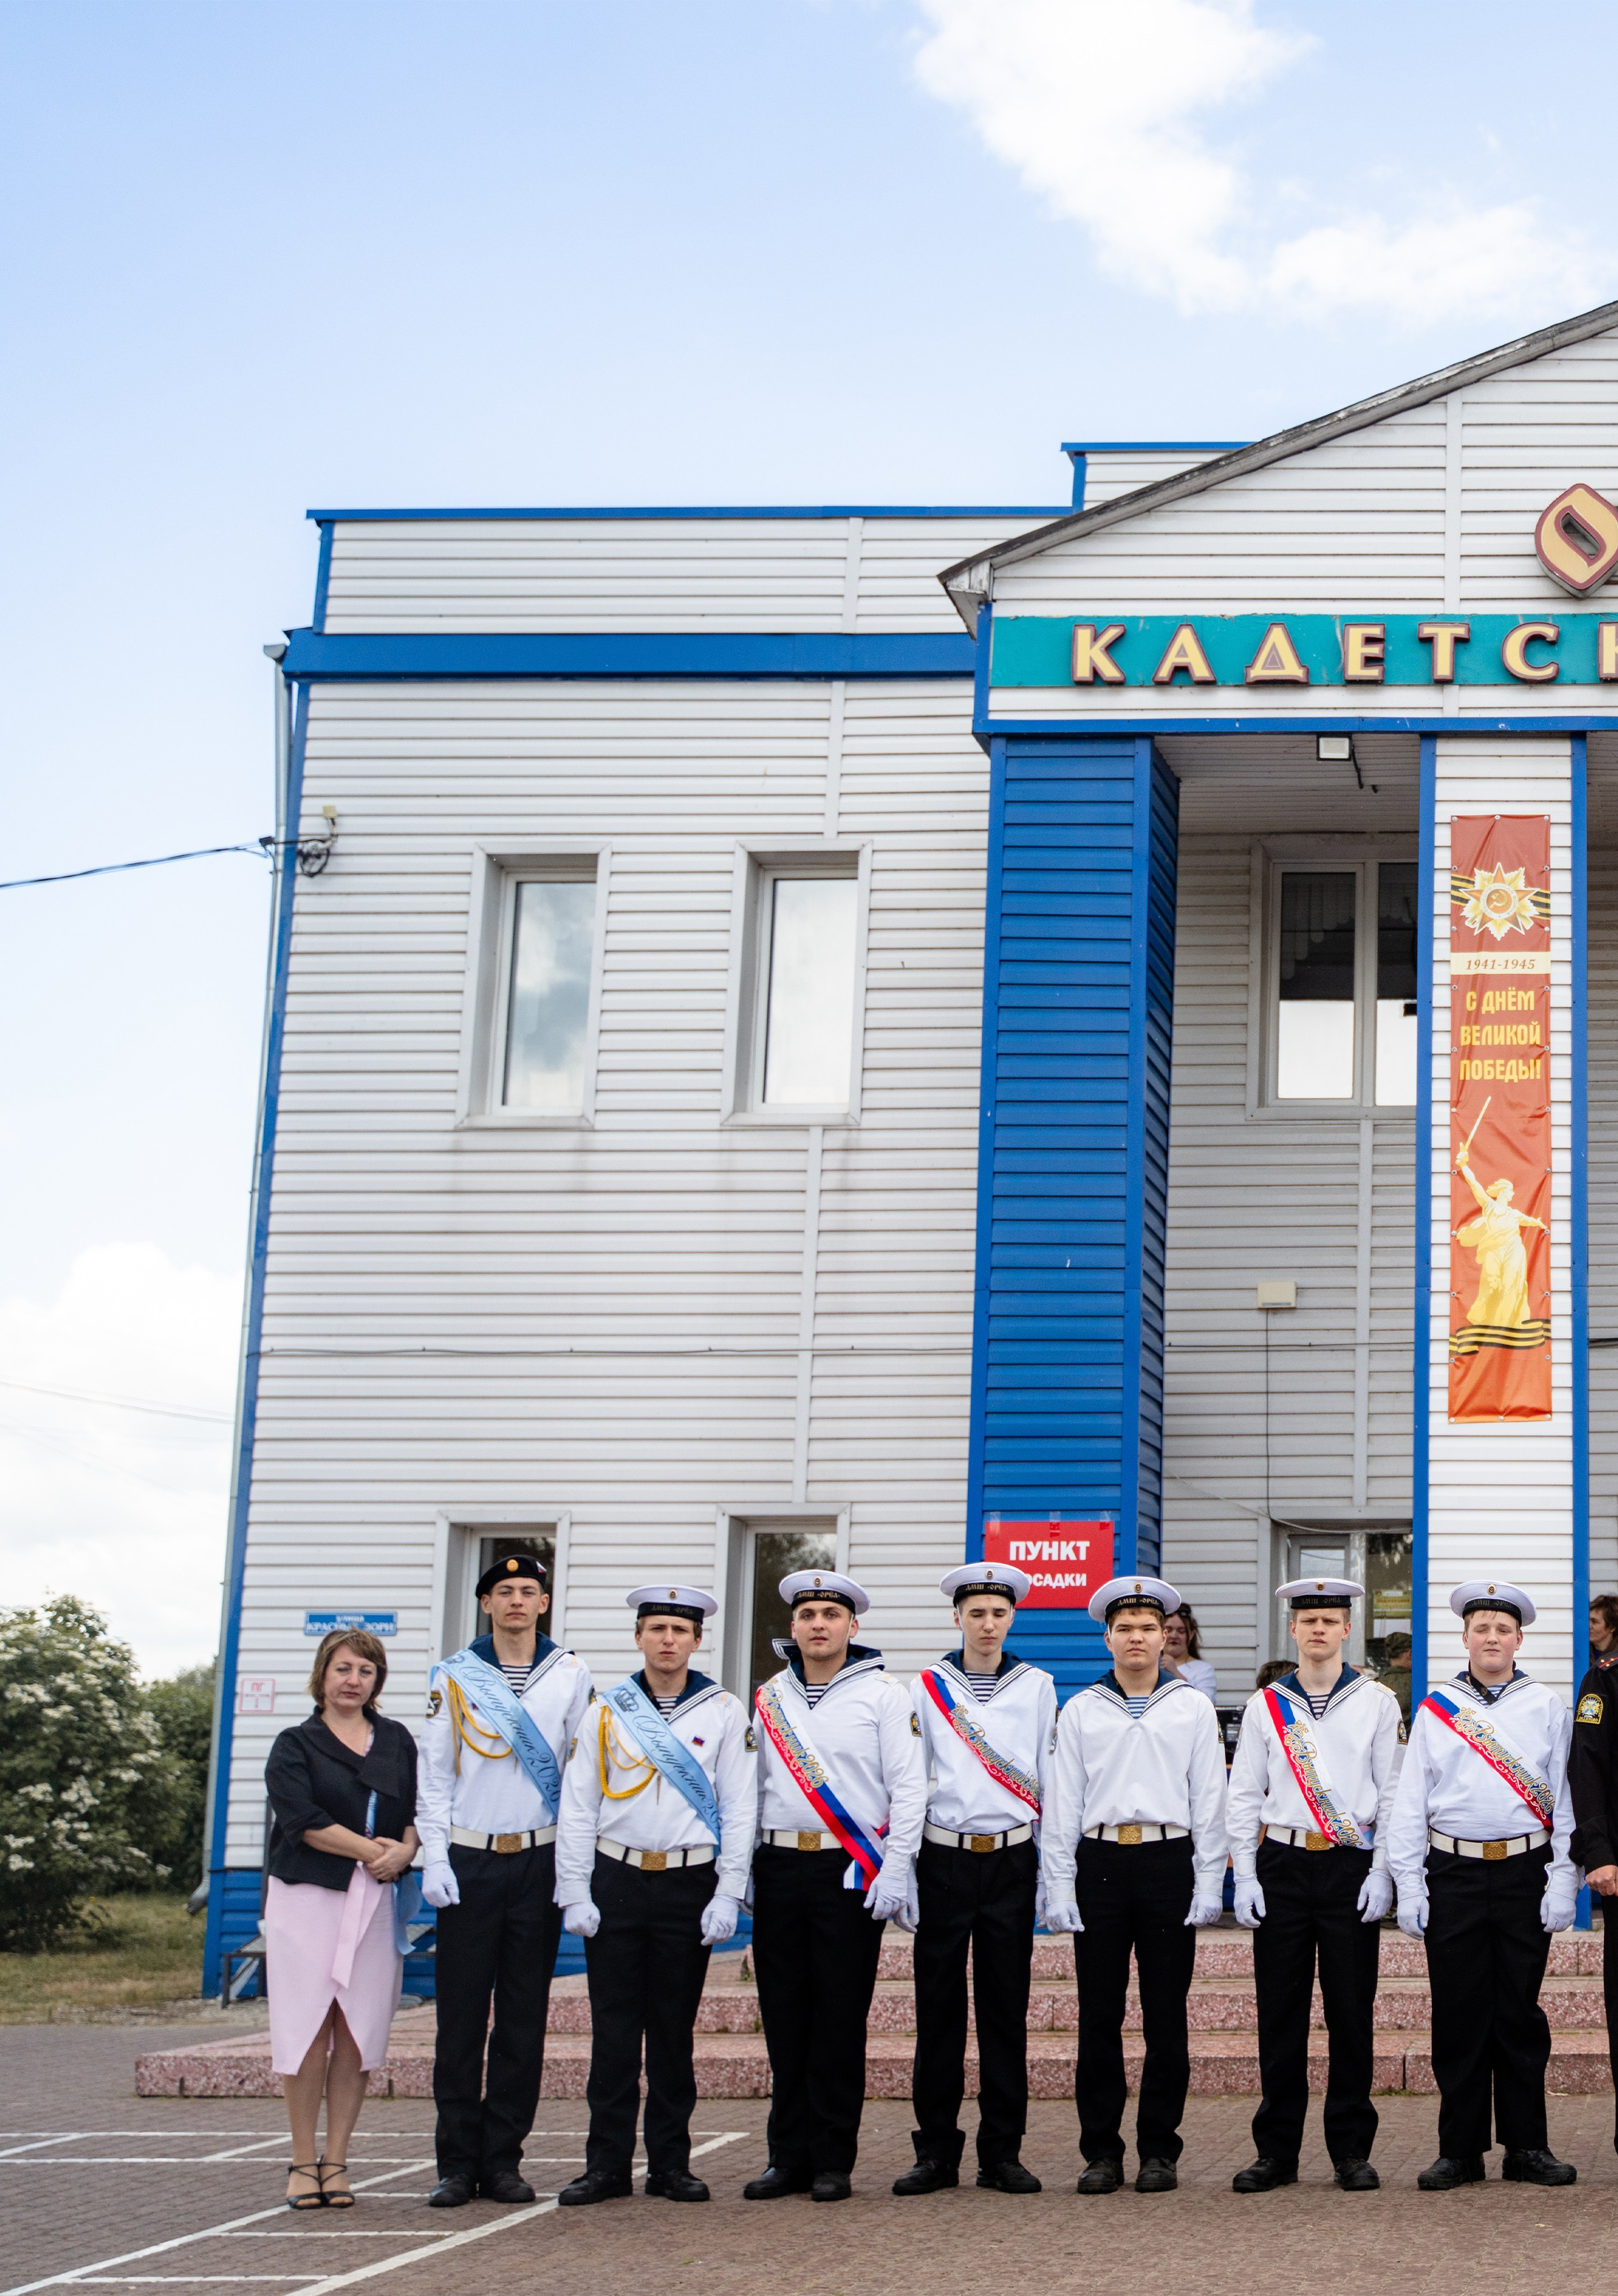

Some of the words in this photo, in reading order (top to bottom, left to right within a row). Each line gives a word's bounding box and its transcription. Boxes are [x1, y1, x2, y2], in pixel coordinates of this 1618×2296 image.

[1466, 959, 1536, 970] 1941-1945
[1466, 991, 1477, 1012] С
[1482, 987, 1535, 1014] ДНЁМ
[1461, 1021, 1540, 1046] ВЕЛИКОЙ
[1459, 1059, 1541, 1083] ПОБЕДЫ!
[1009, 1541, 1090, 1561] ПУНКТ
[459, 1666, 539, 1755] Выпускник
[796, 1754, 829, 1789] 2026
[959, 1721, 1030, 1797] Выпускник
[1470, 1719, 1542, 1800] Выпускник
[1530, 1782, 1556, 1813] 2026
[1294, 1741, 1346, 1833] Выпускник
